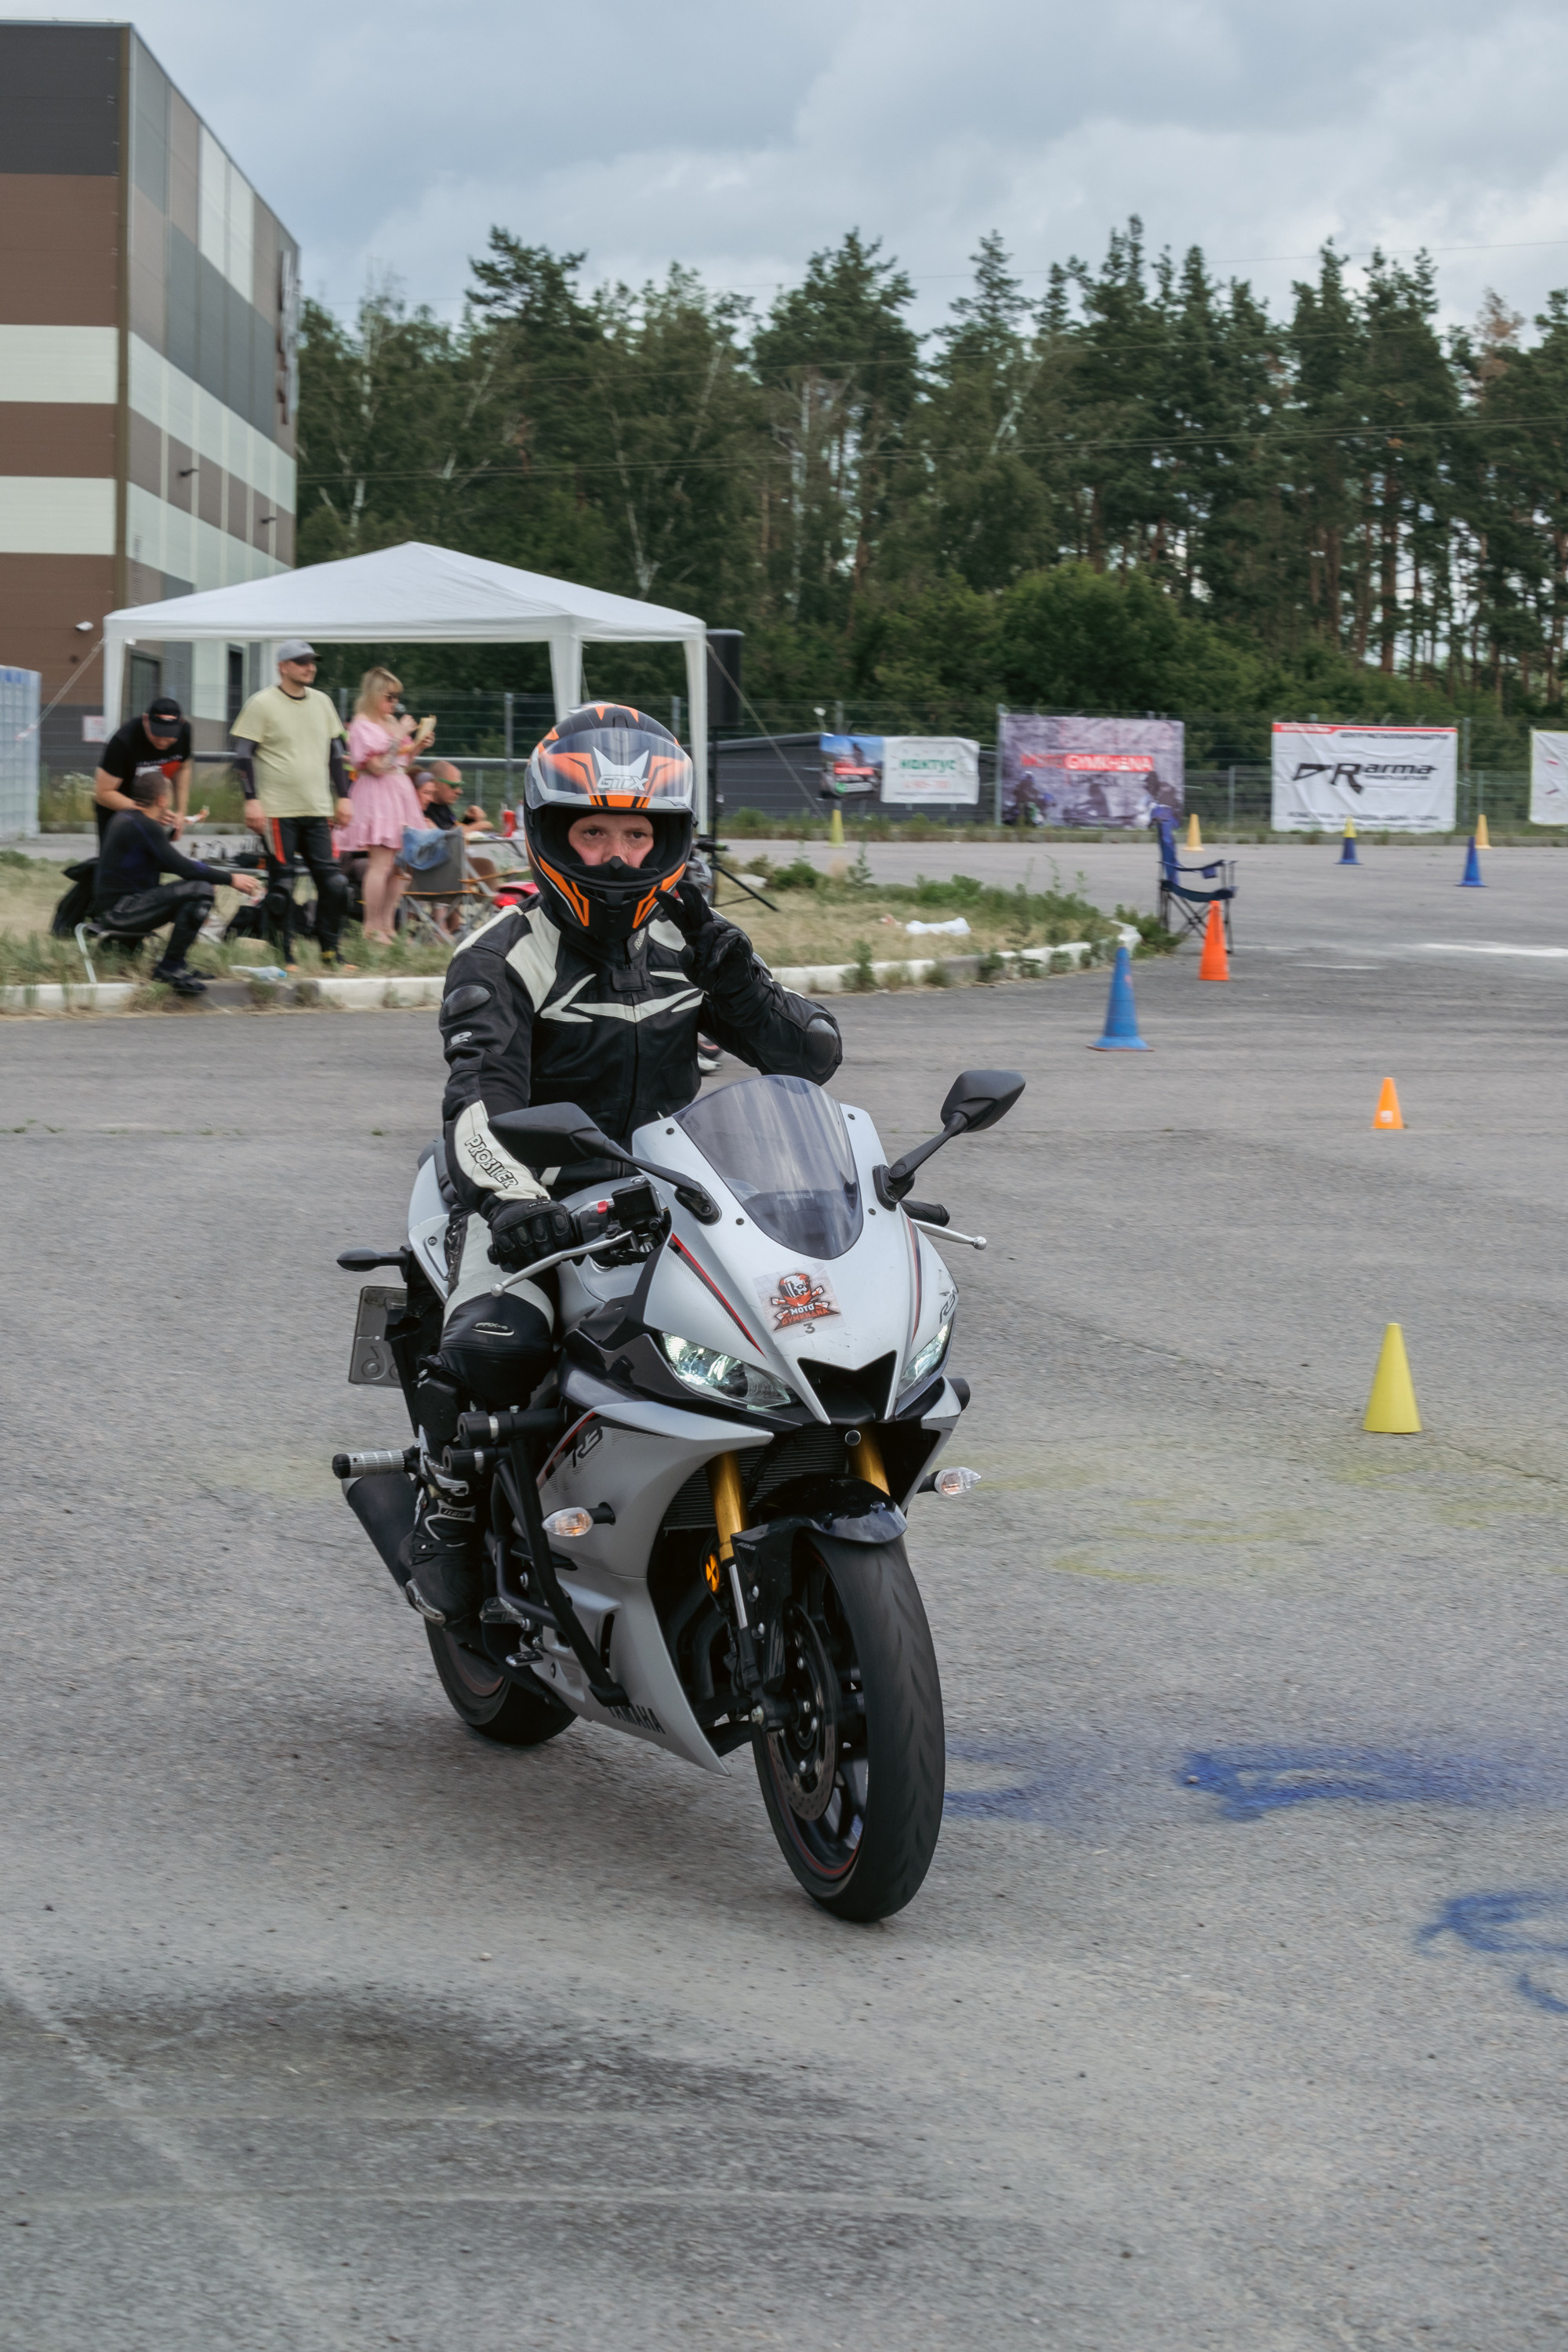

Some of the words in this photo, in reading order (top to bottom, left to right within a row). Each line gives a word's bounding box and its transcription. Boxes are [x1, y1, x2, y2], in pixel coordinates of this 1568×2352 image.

[597, 775, 649, 792] GTX
[782, 1308, 830, 1326] GYMKHANA
[789, 1303, 815, 1316] MOTO
[804, 1322, 816, 1334] 3
